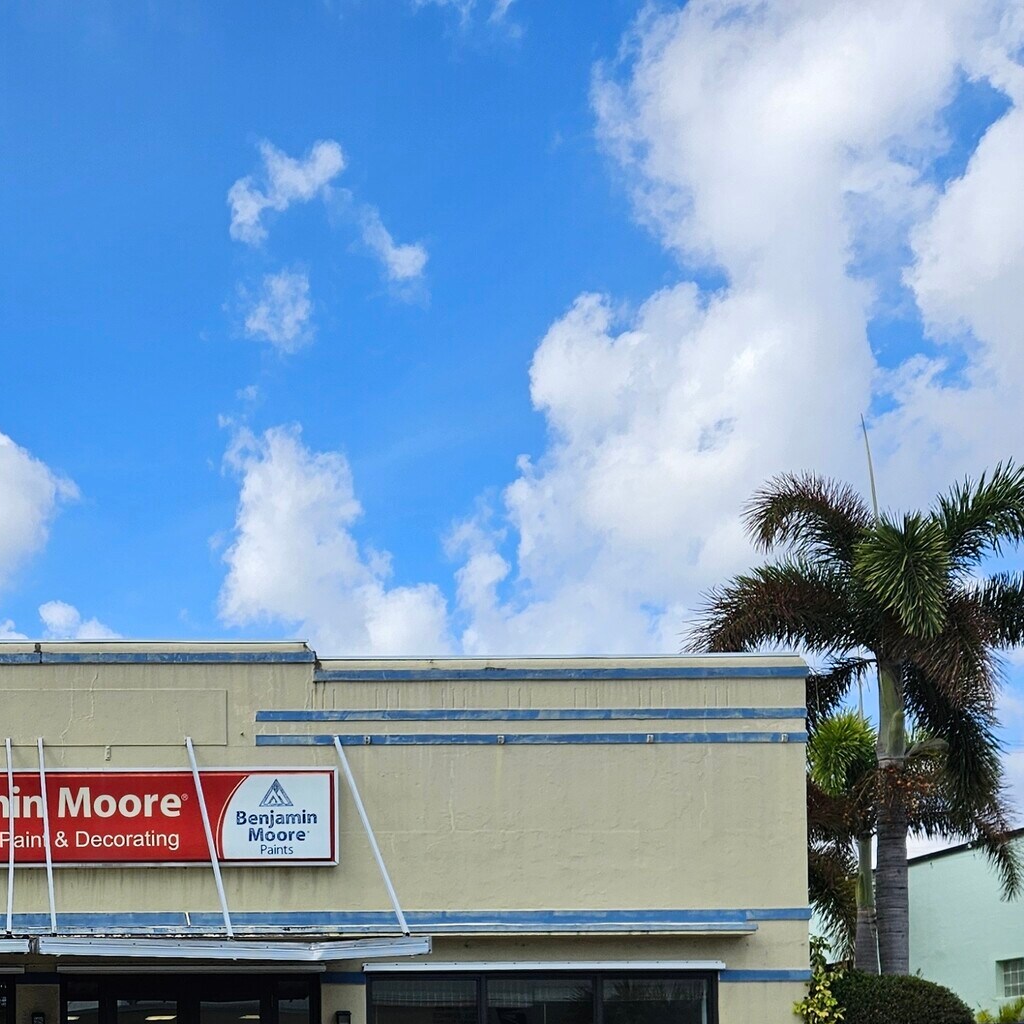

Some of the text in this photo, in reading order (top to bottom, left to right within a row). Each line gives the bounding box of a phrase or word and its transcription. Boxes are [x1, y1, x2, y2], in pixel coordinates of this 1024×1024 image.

[236, 809, 318, 828] Benjamin
[54, 831, 69, 848] &
[75, 830, 180, 850] Decorating
[248, 828, 306, 841] Moore
[260, 844, 294, 855] Paints
